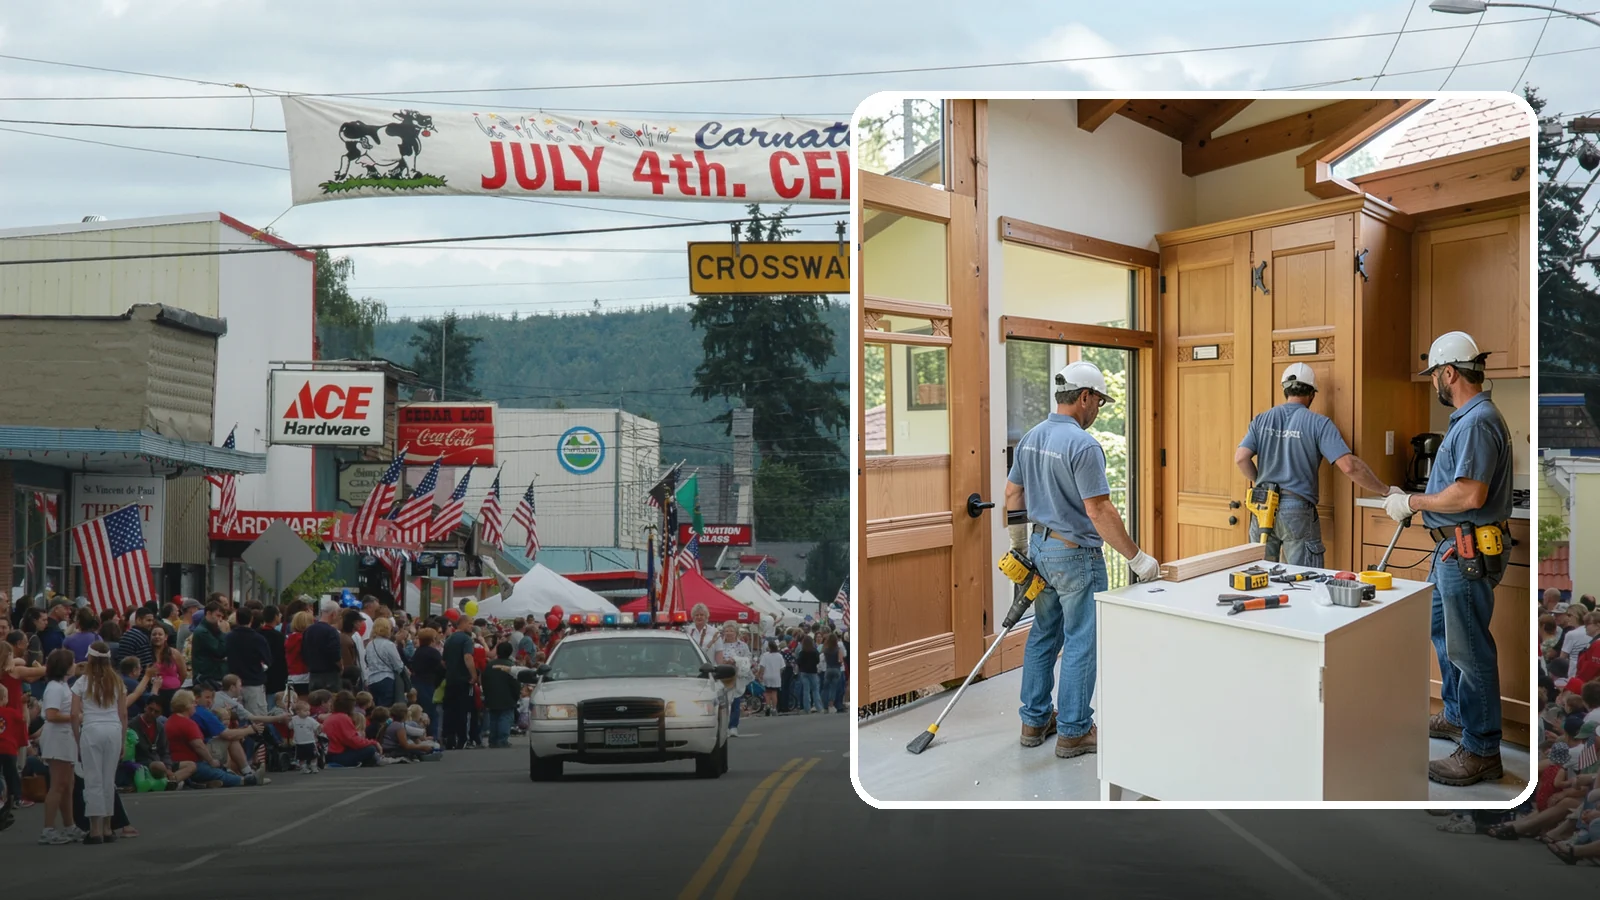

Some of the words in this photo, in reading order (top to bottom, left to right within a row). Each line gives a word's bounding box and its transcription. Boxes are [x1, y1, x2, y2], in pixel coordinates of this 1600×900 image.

[481, 141, 604, 192] JULY
[632, 150, 746, 197] 4th.
[696, 254, 850, 280] CROSSWA
[283, 380, 373, 420] ACE
[406, 409, 452, 422] CEDAR
[462, 409, 485, 422] LOG
[284, 421, 370, 436] Hardware
[95, 485, 124, 494] Vincent
[126, 485, 135, 494] de
[137, 486, 155, 495] Paul
[688, 526, 741, 535] CRNATION
[699, 535, 730, 543] GLASS
